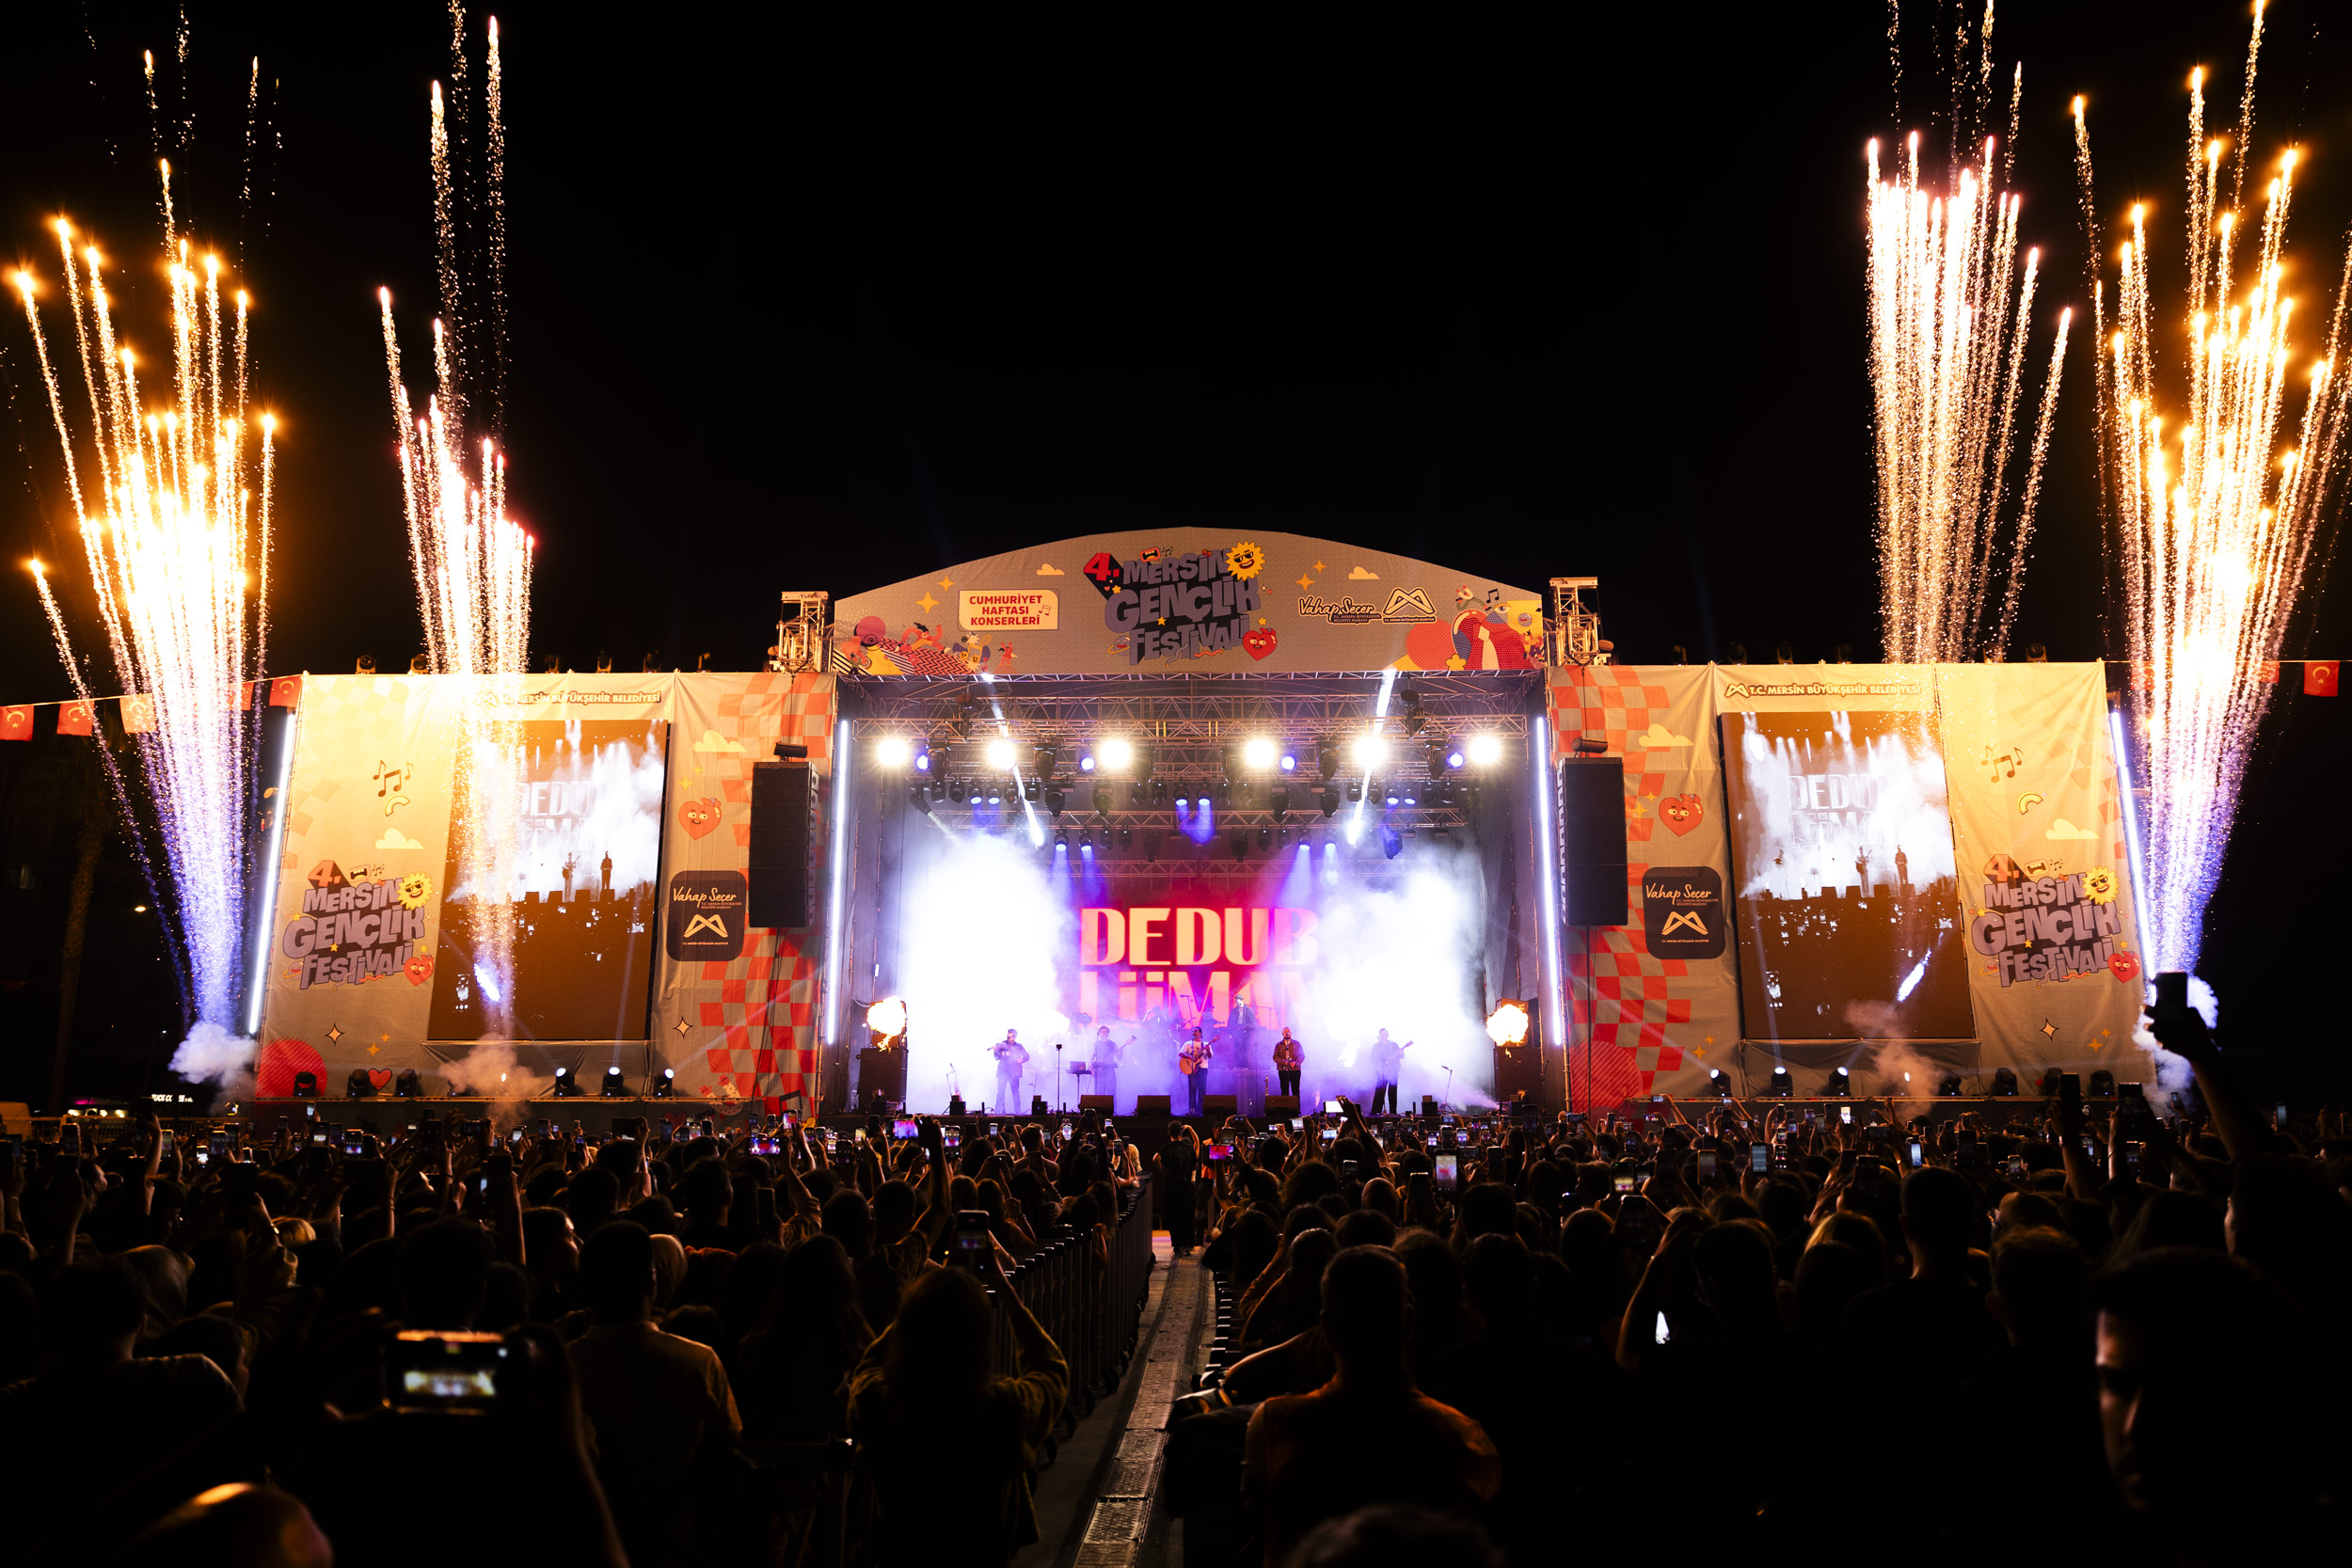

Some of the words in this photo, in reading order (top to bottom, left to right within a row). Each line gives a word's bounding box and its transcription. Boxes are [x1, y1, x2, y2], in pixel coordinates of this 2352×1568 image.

[1083, 552, 1120, 582] 4.
[969, 593, 1042, 605] CUMHURİYET
[981, 606, 1029, 615] HAFTASI
[1104, 576, 1262, 634] GENÇLİK
[1299, 595, 1339, 622] Vahap
[970, 614, 1041, 626] KONSERLERİ
[1129, 613, 1250, 666] FESTİVALİ
[551, 691, 611, 705] BÜYÜKŞEHİR
[612, 691, 660, 704] BELEDİYESİ
[1749, 686, 1766, 695] T.C.
[1768, 683, 1804, 695] MERSİN
[1806, 683, 1868, 697] BÜYÜKŞEHİR
[308, 860, 342, 888] 4.
[1982, 854, 2020, 882] 4.
[673, 886, 707, 909] Vahap
[708, 887, 738, 902] Seçer
[1645, 882, 1681, 906] Vahap
[1683, 883, 1712, 899] Seçer
[282, 905, 425, 959] GENÇLİK
[1080, 907, 1318, 966] DEDUB
[1971, 899, 2122, 957] GENÇLİK
[299, 941, 414, 990] FESTİVALİ
[1998, 937, 2115, 988] FESTİVALİ
